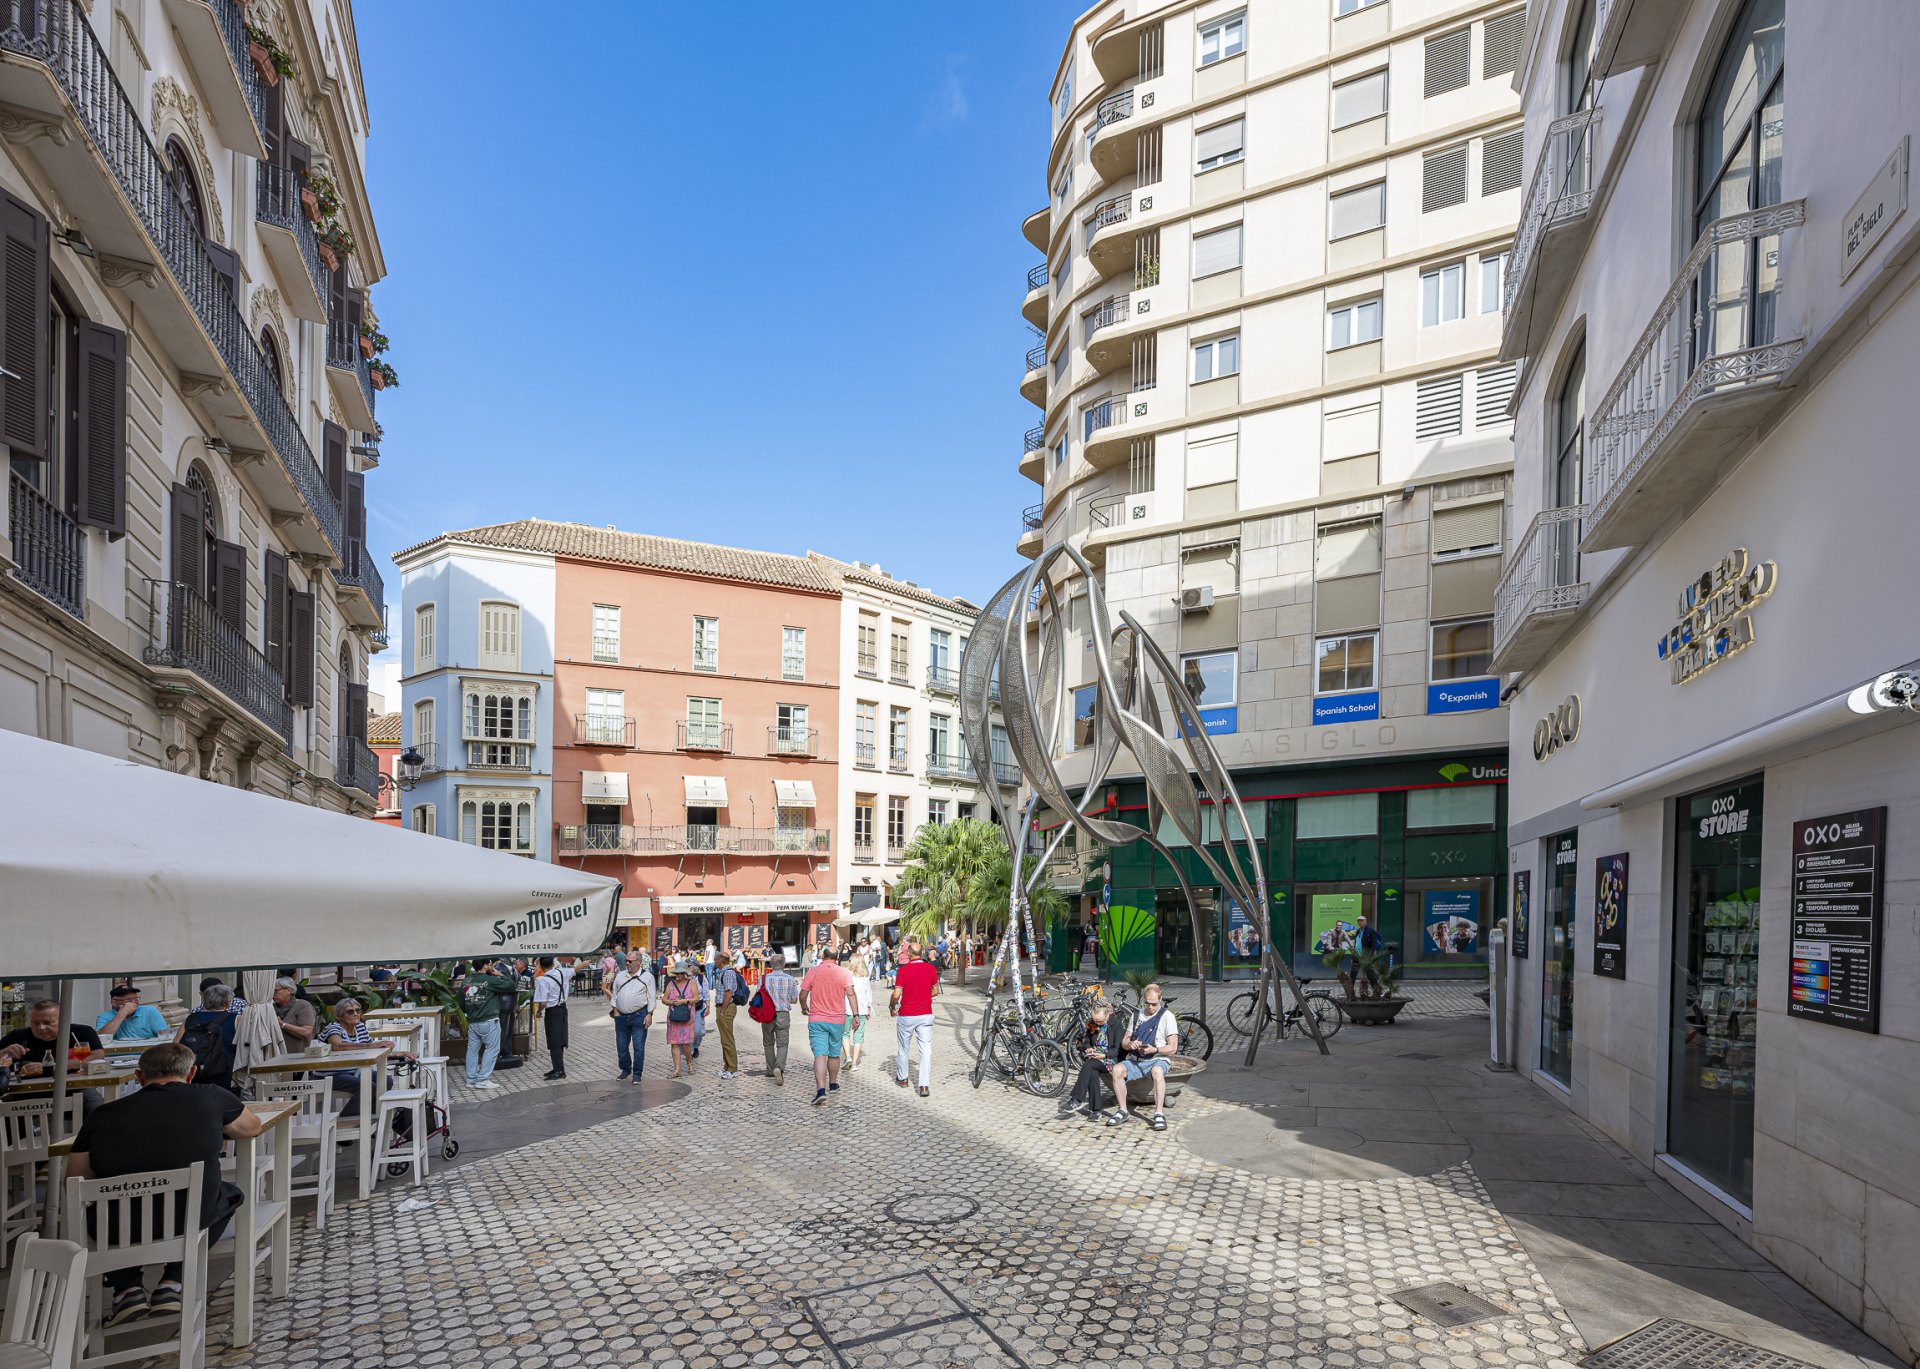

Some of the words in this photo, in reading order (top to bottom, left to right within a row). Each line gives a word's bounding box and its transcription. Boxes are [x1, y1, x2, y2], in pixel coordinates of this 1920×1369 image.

[1847, 212, 1865, 240] PLAZA
[1847, 235, 1861, 257] DEL
[1862, 202, 1884, 239] SIGLO
[1677, 549, 1746, 620] MUSEO
[1447, 691, 1488, 704] Expanish
[1315, 706, 1348, 717] Spanish
[1348, 703, 1376, 713] School
[1533, 694, 1581, 762] OXO
[1276, 725, 1397, 754] SIGLO
[1711, 795, 1735, 815] OXO
[1699, 809, 1749, 839] STORE
[1804, 823, 1841, 846] OXO
[1561, 839, 1572, 851] OXO
[1556, 849, 1577, 866] STORE
[1798, 859, 1805, 869] 0
[1799, 881, 1804, 891] 1
[531, 890, 562, 899] CERVEZAS
[1797, 903, 1804, 913] 2
[1796, 925, 1803, 934] 3
[1792, 1003, 1804, 1012] OXO
[273, 1083, 314, 1092] astoria
[99, 1177, 170, 1193] astoria
